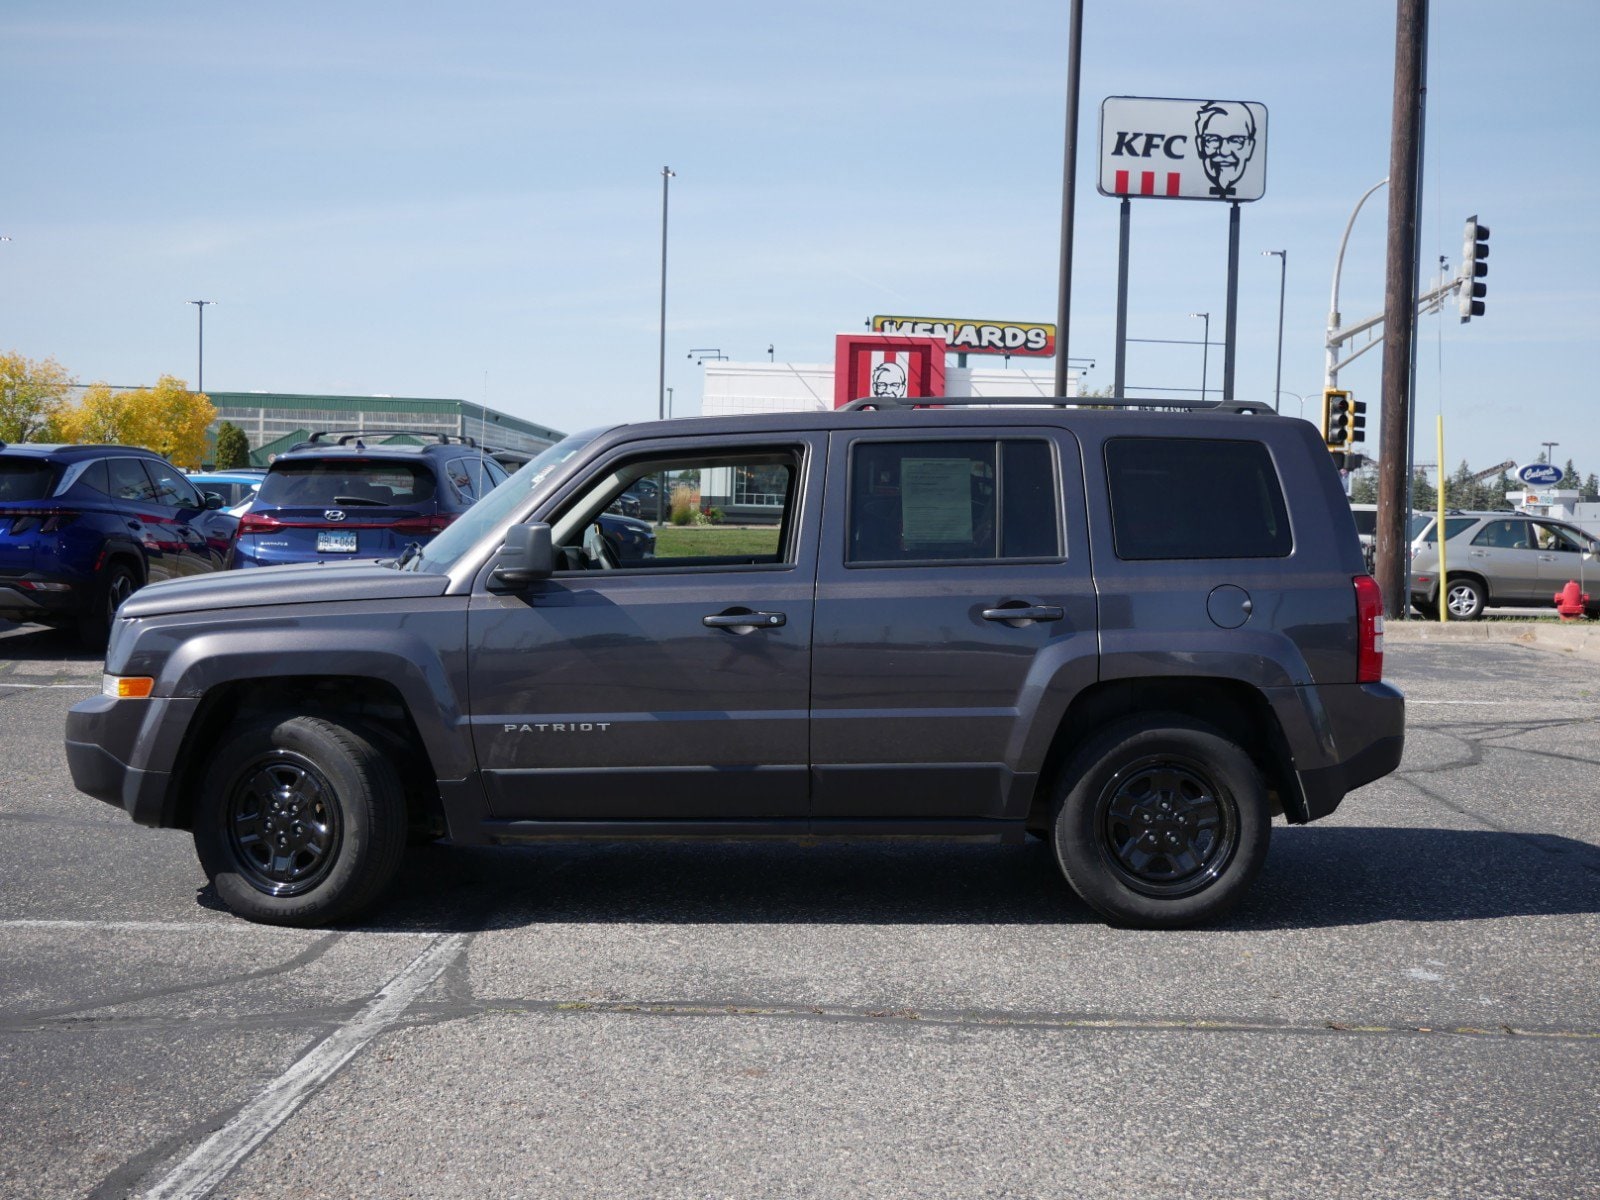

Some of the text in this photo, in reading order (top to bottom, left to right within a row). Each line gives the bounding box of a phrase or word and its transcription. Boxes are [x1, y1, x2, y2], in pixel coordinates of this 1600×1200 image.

[1111, 131, 1188, 160] KFC
[881, 320, 1048, 350] MENARDS
[504, 723, 611, 733] PATRIOT
